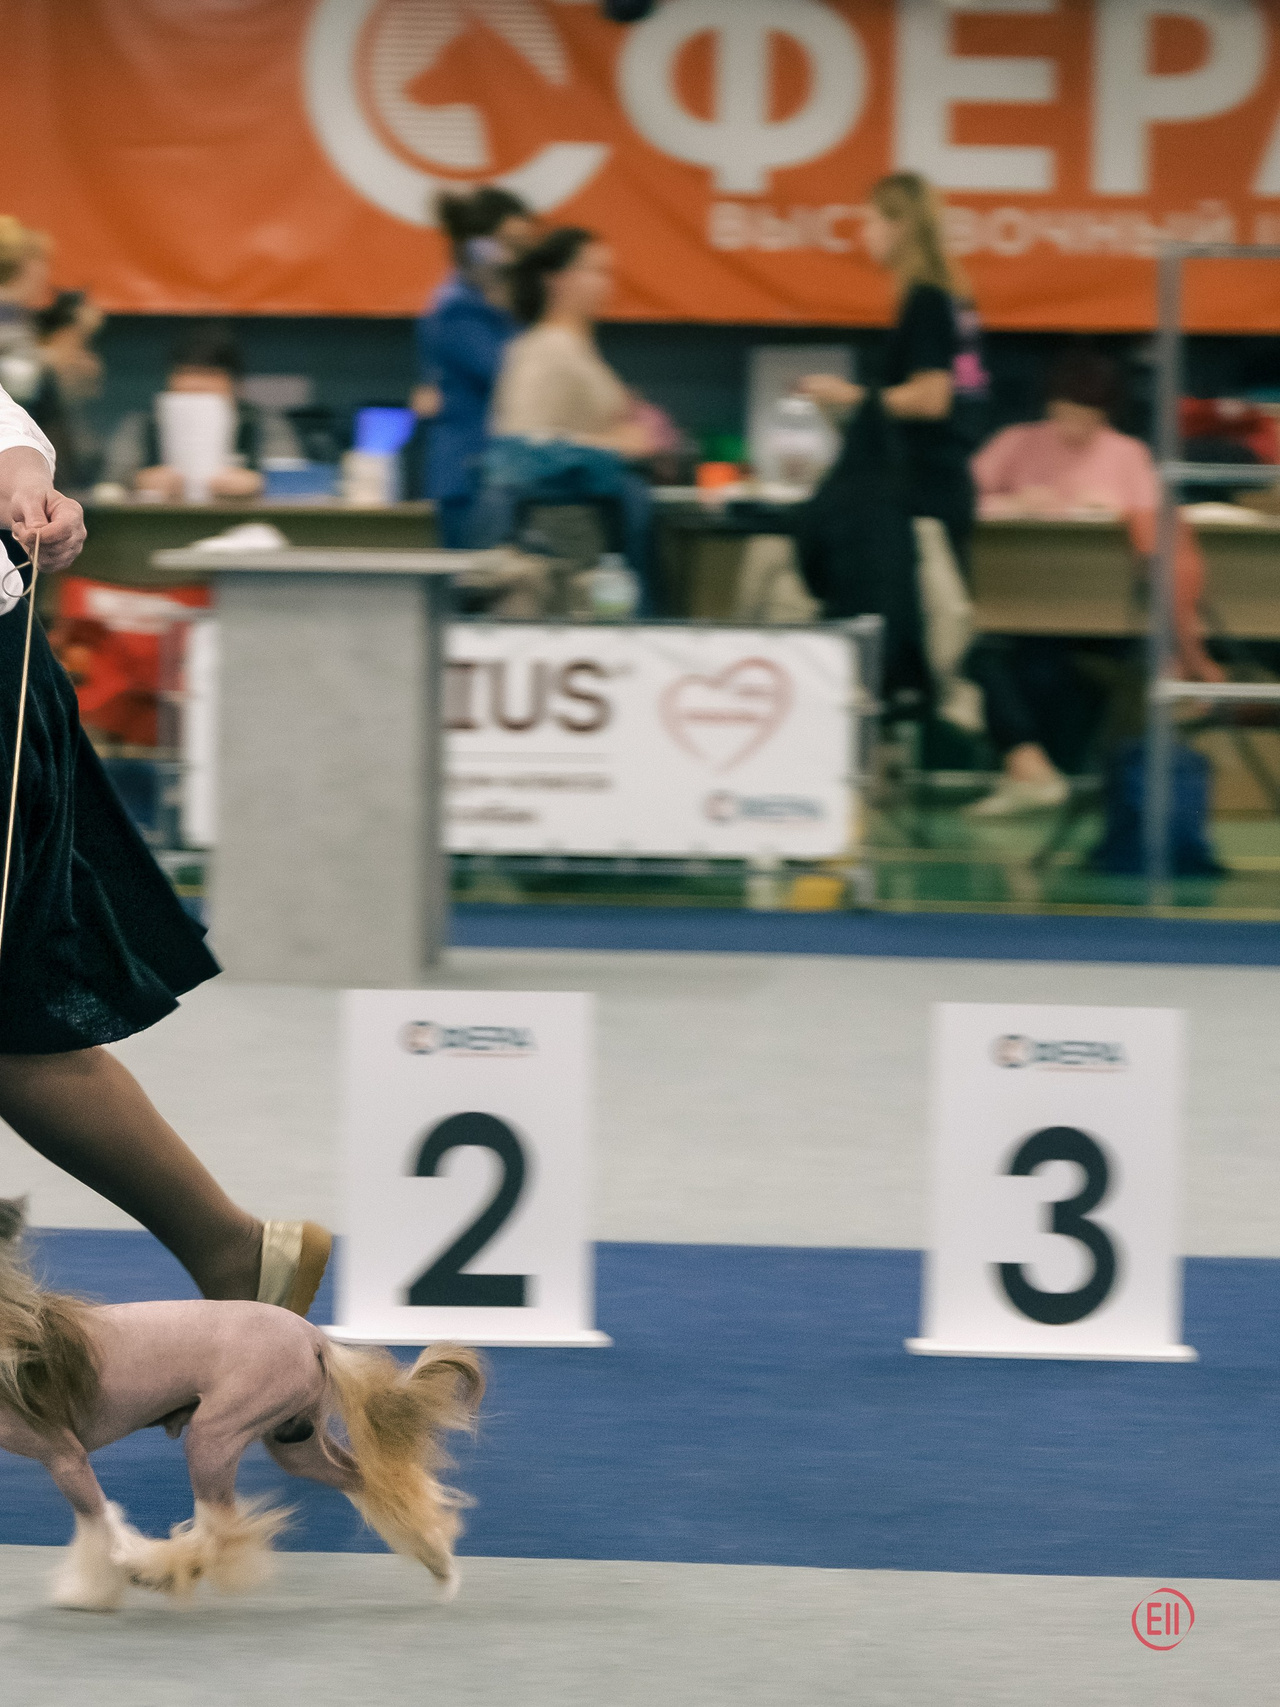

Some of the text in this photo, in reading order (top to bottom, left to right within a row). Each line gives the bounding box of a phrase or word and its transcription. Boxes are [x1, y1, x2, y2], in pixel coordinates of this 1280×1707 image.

[303, 0, 1280, 228] СФЕР
[404, 1111, 532, 1307] 2
[992, 1126, 1122, 1325] 3
